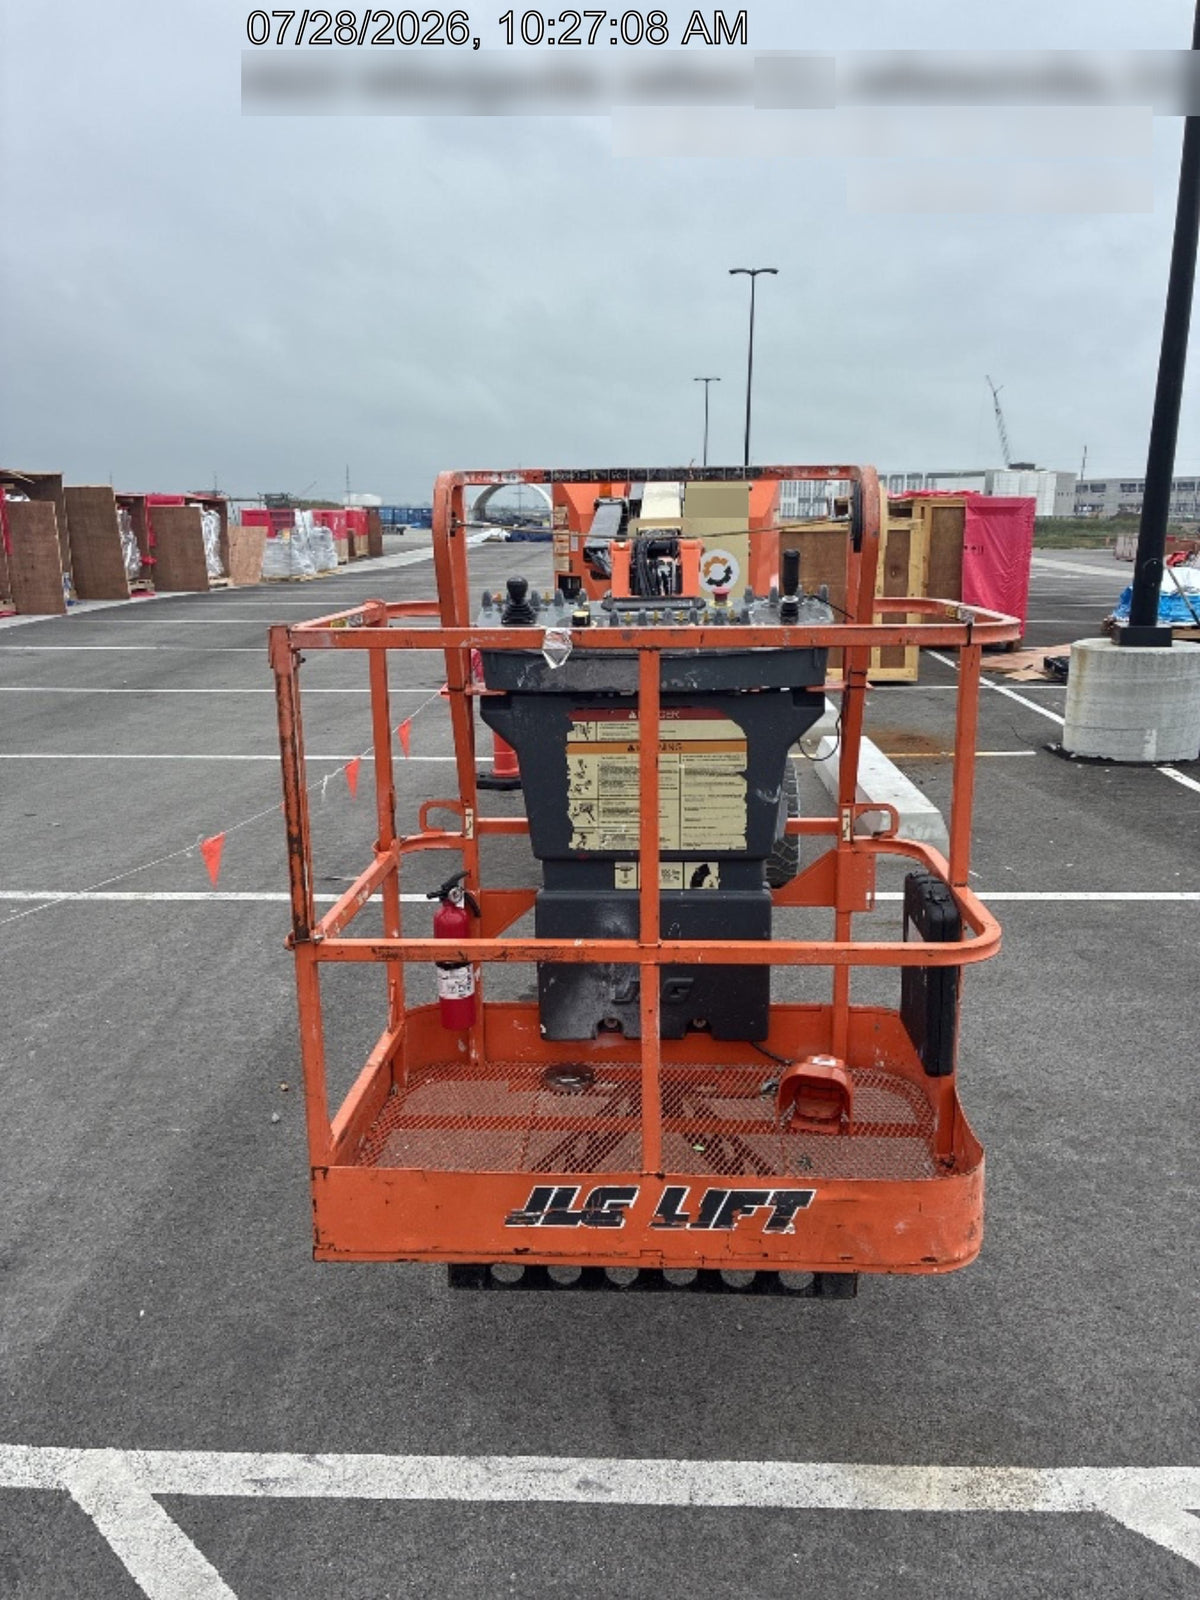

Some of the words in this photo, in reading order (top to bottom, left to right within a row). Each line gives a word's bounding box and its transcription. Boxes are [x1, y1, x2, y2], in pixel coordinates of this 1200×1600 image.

[611, 977, 694, 1005] JG
[505, 1185, 640, 1228] JLG
[649, 1186, 817, 1234] LIFT
